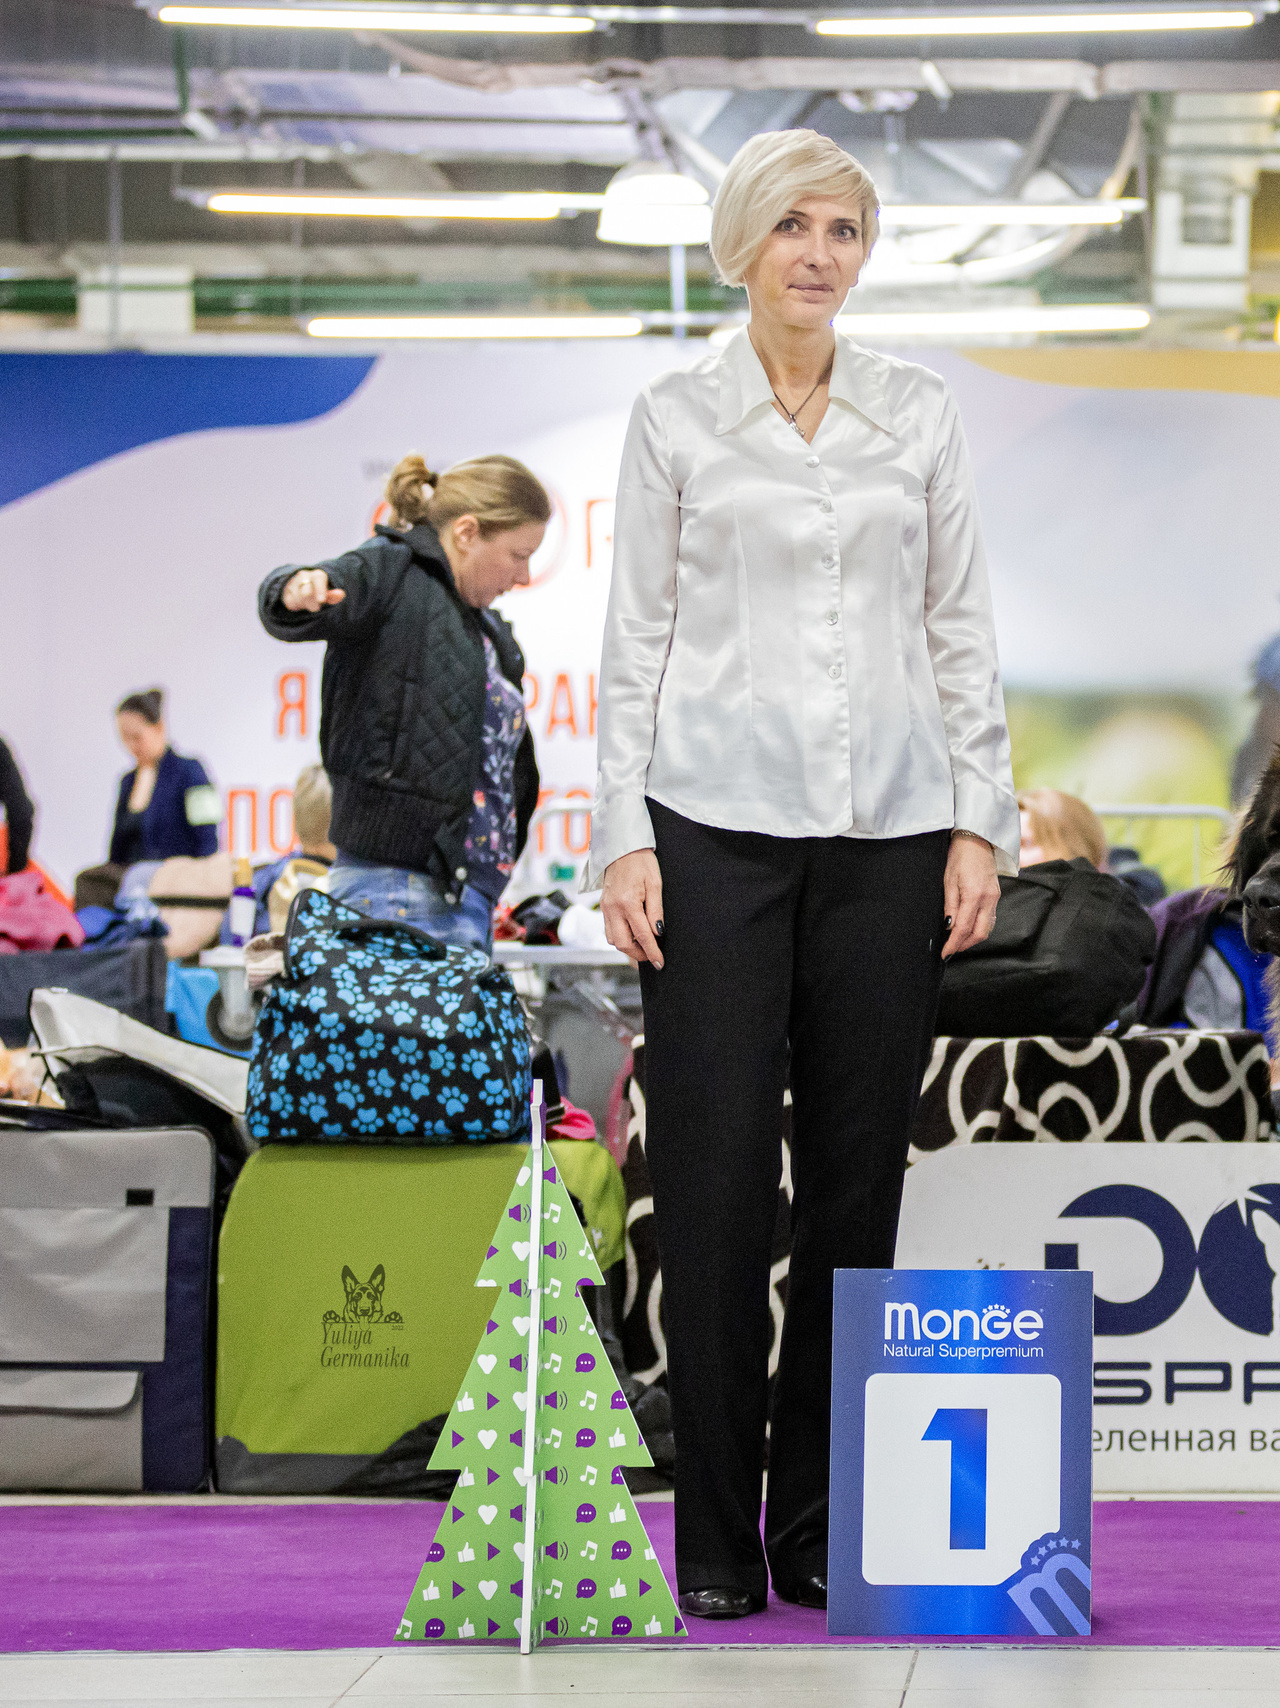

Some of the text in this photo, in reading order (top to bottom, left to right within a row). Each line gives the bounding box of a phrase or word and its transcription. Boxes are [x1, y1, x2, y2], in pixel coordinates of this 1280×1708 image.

[277, 672, 307, 736] Я
[322, 1323, 372, 1350] Yuliya
[320, 1346, 409, 1367] Germanika
[883, 1343, 1044, 1360] Natural Superpremium
[921, 1408, 988, 1550] 1
